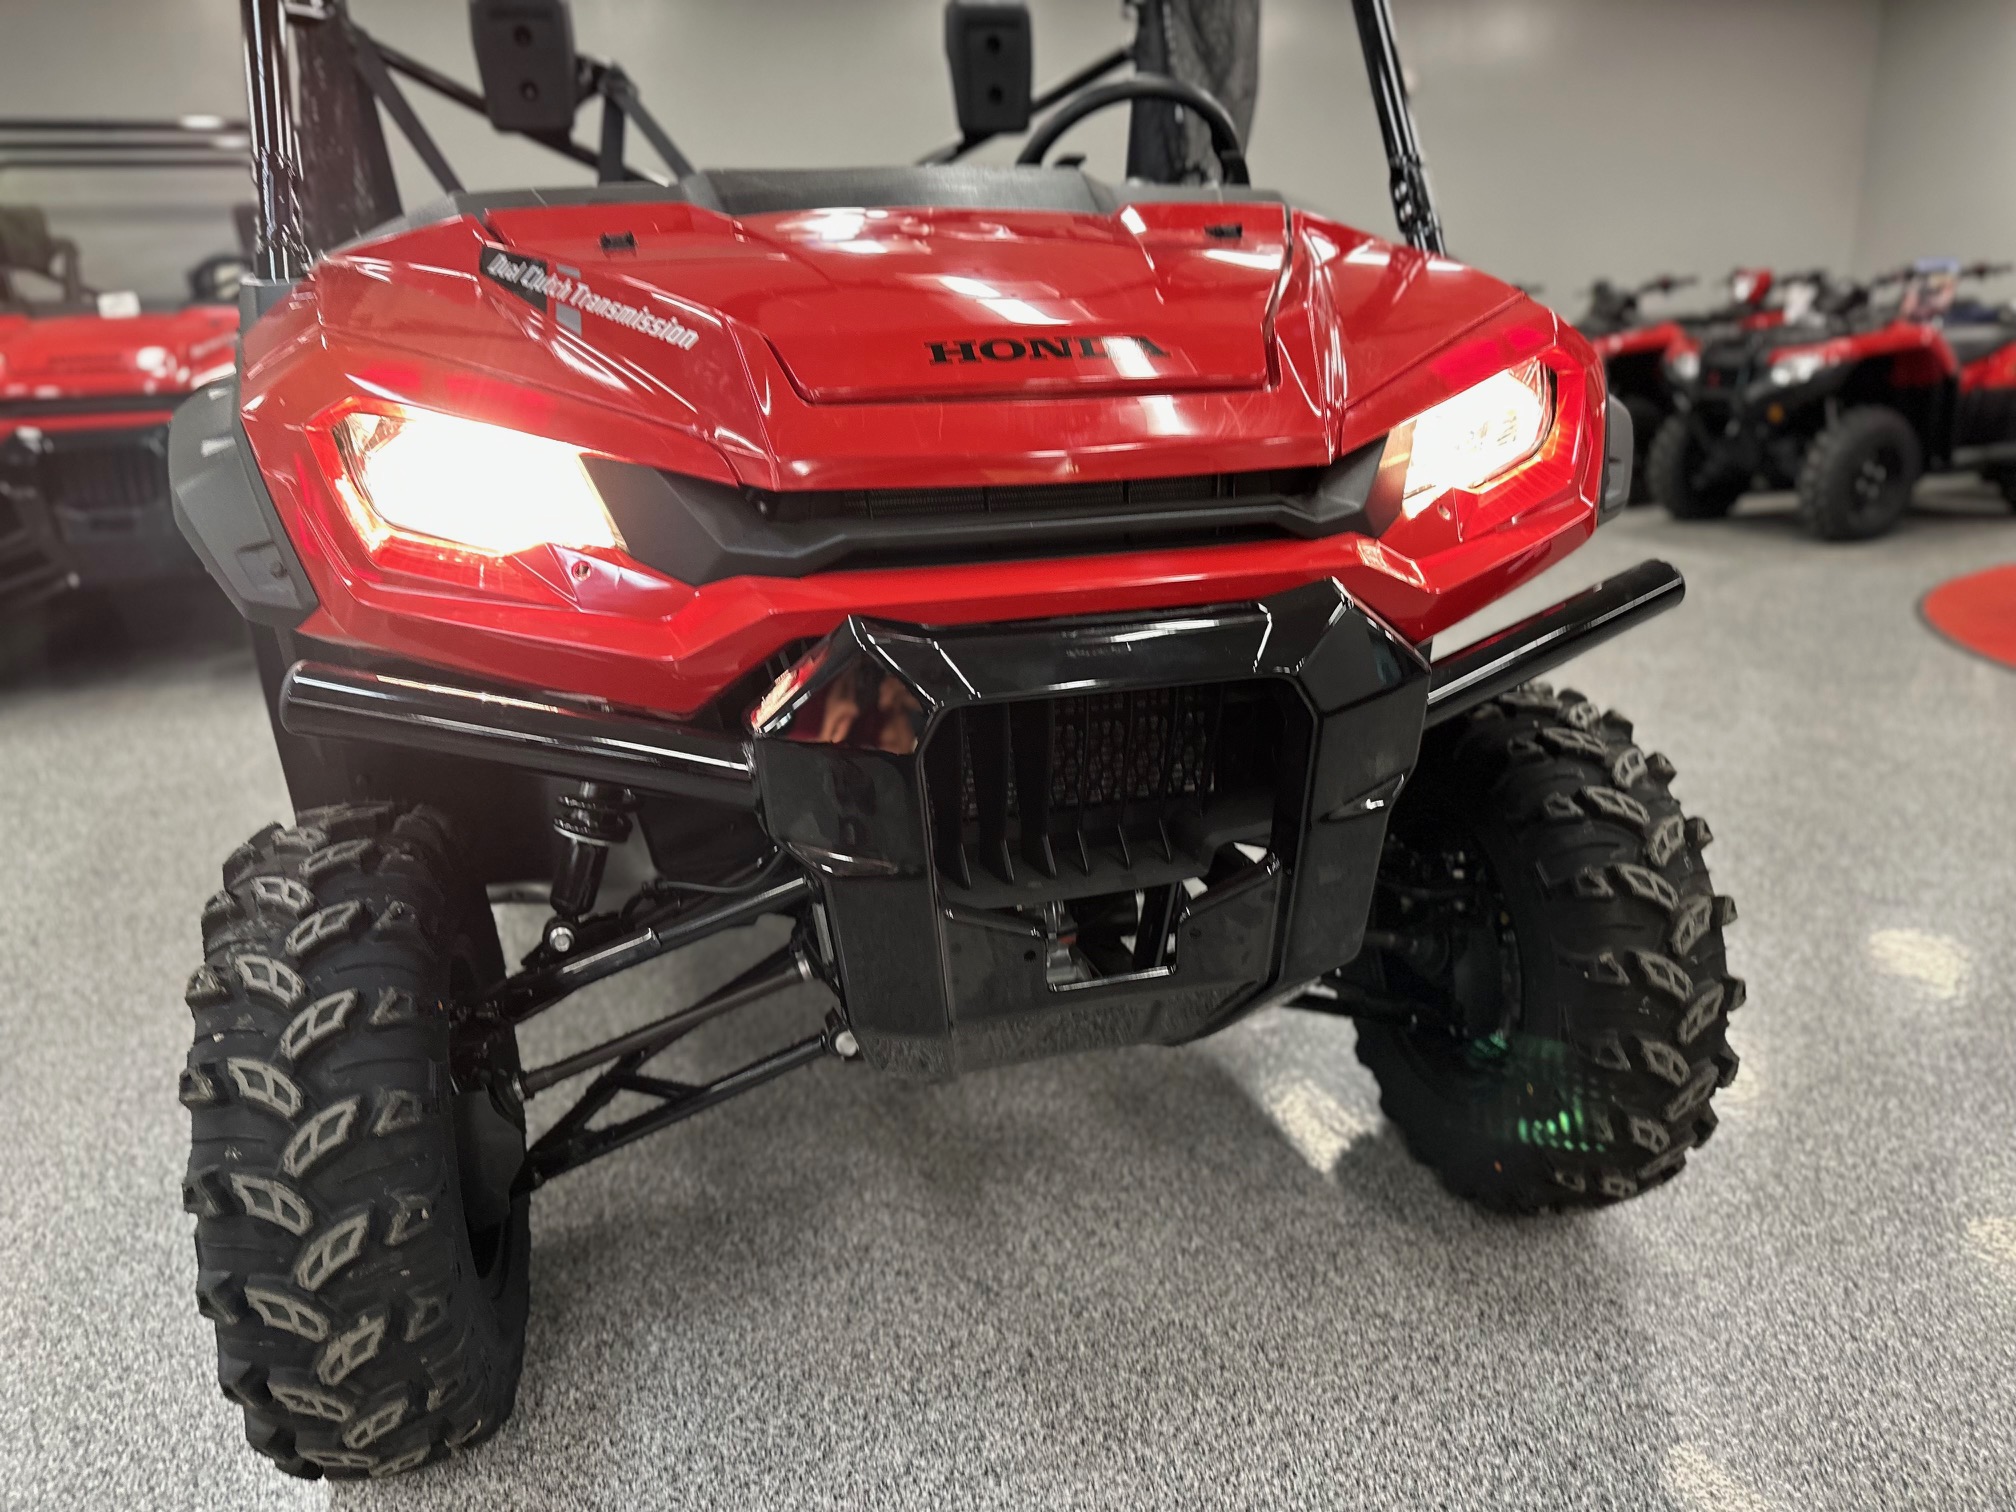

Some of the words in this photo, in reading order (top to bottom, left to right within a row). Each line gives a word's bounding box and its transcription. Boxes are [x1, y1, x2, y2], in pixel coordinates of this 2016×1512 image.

[487, 253, 526, 283] Dual
[520, 262, 573, 302] Clutch
[569, 281, 699, 351] Transmission
